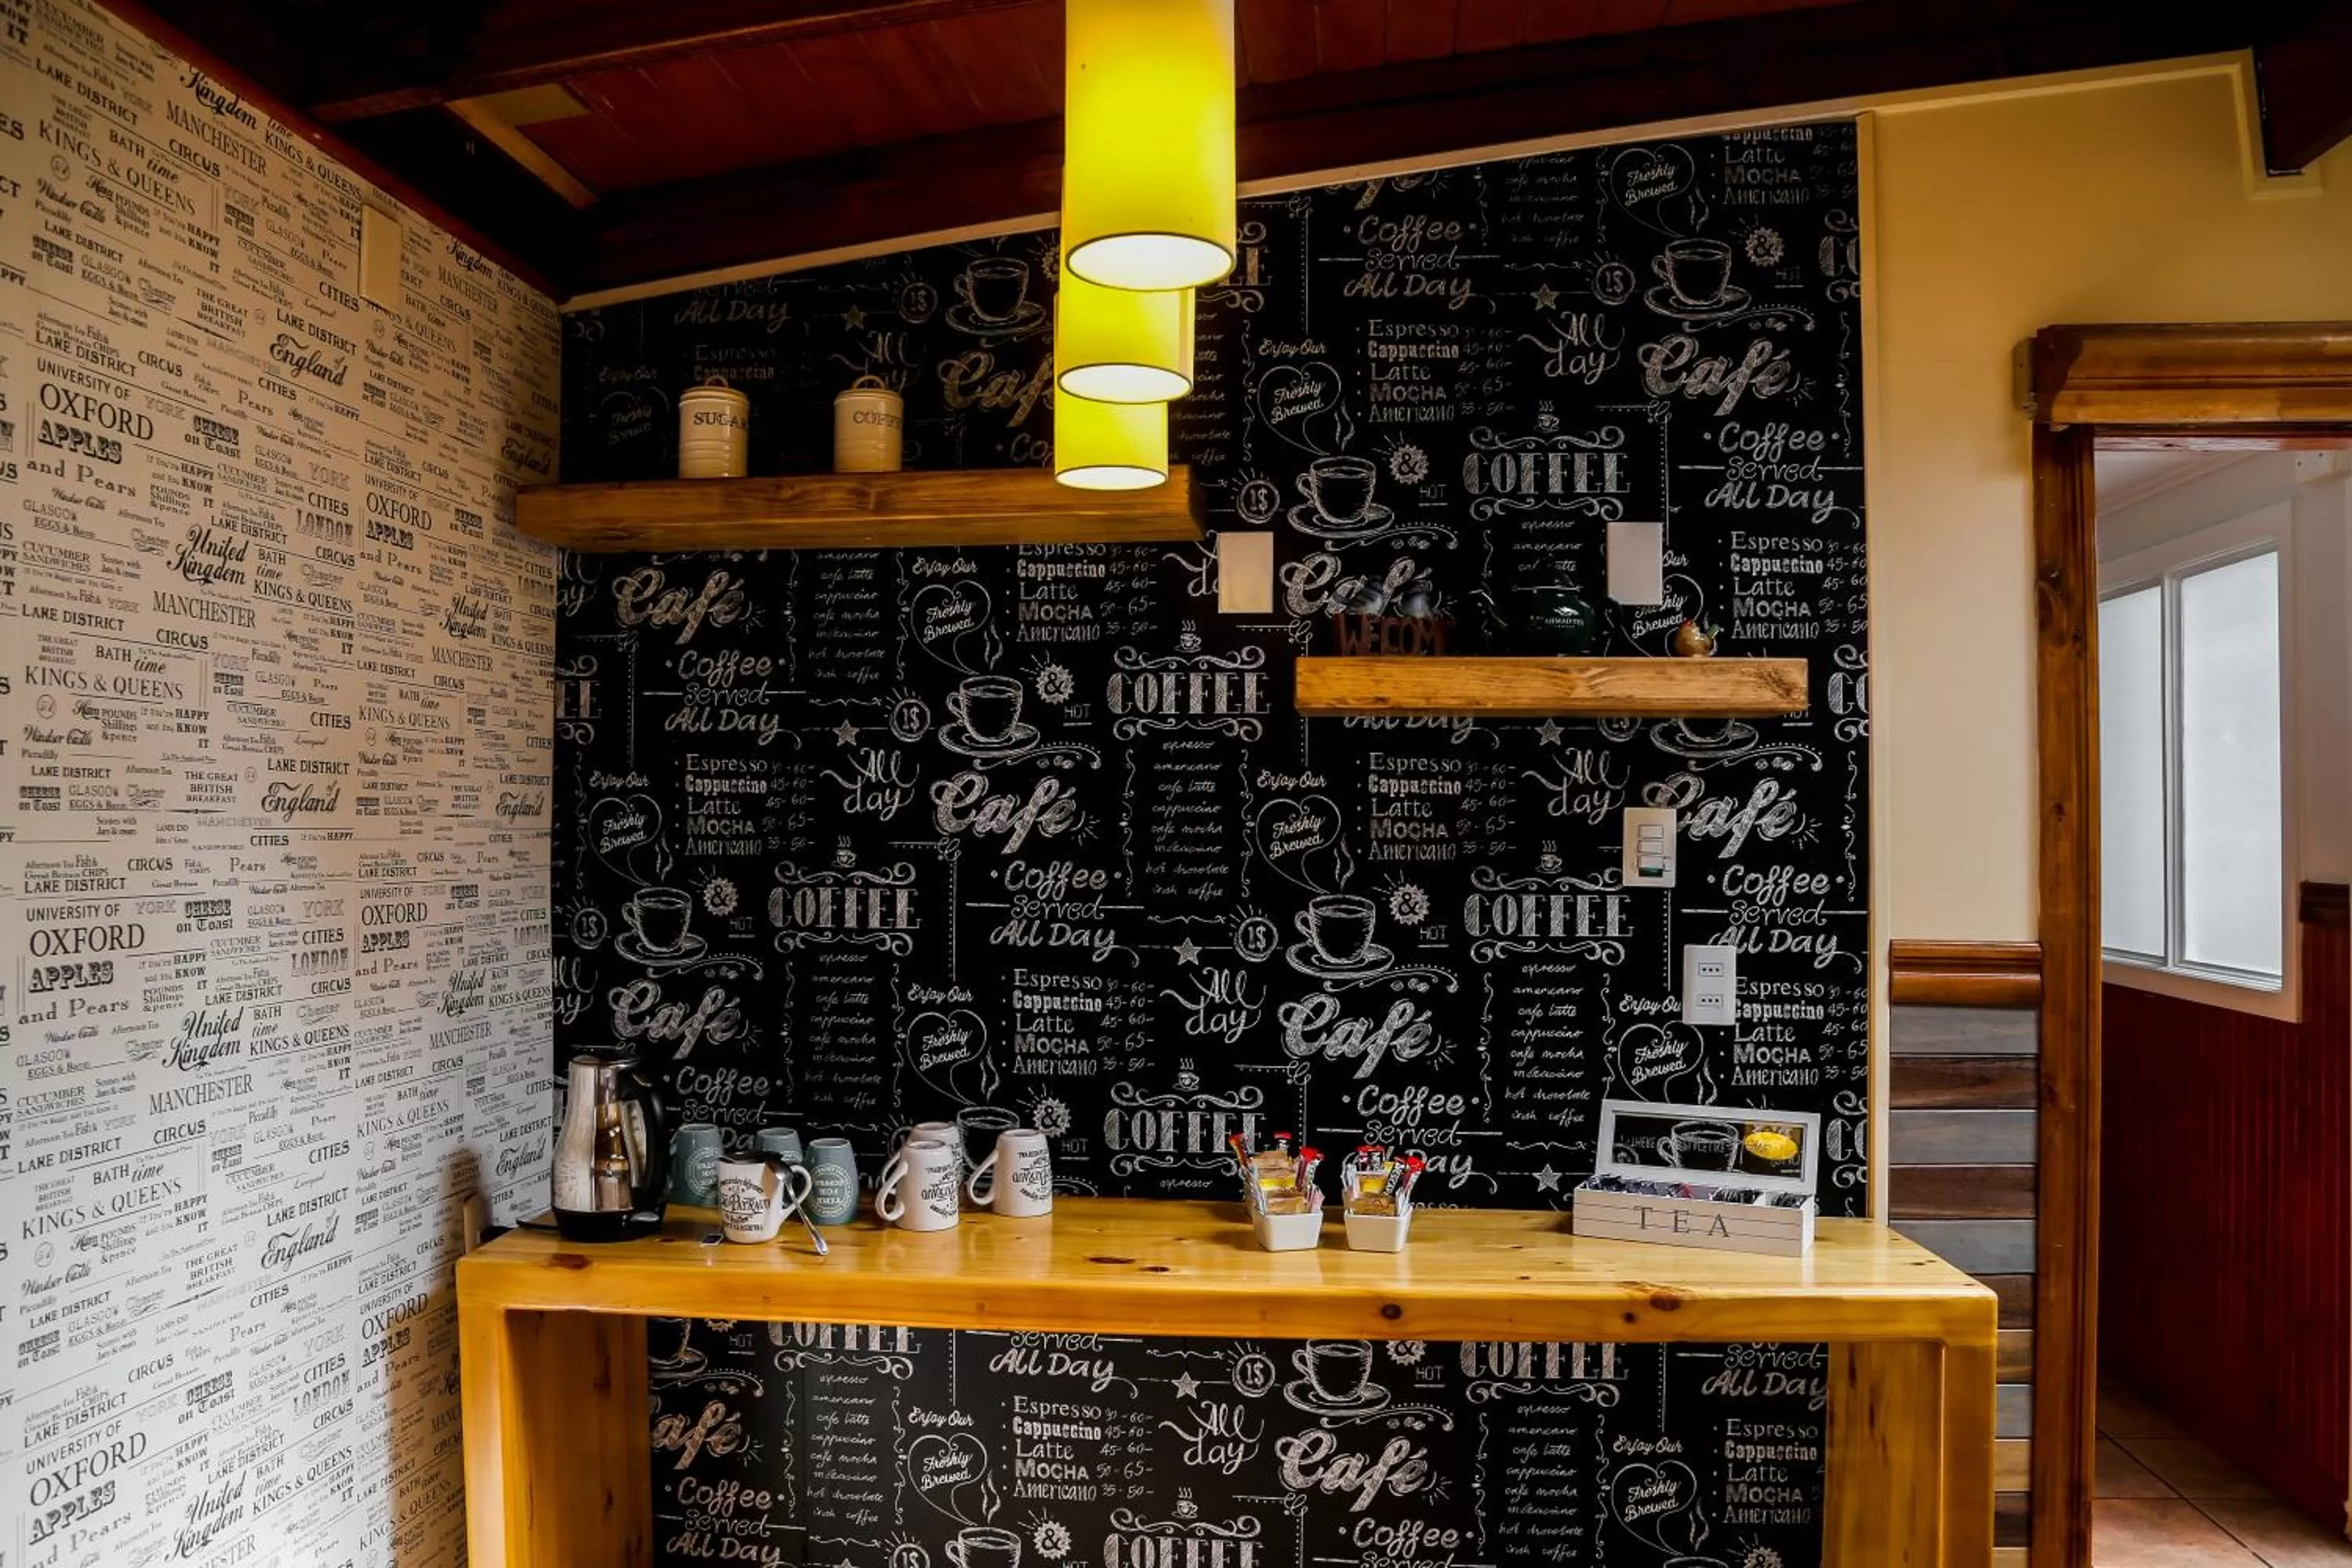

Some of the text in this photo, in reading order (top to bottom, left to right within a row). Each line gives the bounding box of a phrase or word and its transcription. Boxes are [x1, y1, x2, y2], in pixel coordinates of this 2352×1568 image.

[37, 58, 72, 89] LAKE
[78, 80, 139, 125] DISTRICT
[180, 65, 257, 130] Kingdom
[110, 129, 144, 158] BATH
[166, 100, 267, 176] MANCHESTER
[39, 119, 195, 216] KINGS & QUEENS
[169, 139, 220, 177] CIRCUS
[1358, 215, 1463, 251] Coffee
[1366, 245, 1460, 271] Served
[319, 282, 359, 312] CITIES
[1344, 274, 1471, 310] All Day
[277, 308, 358, 355] LAKE DISTRICT
[1368, 320, 1459, 339] Espresso
[138, 351, 183, 377] CIRCUS
[1367, 341, 1459, 361] Cappuccino
[37, 358, 131, 400] UNIVERSITY OF
[259, 377, 297, 401] CITIES
[1637, 333, 1791, 416] Café
[40, 383, 154, 441] OXFORD
[1369, 403, 1454, 422] Americano
[38, 419, 122, 464] APPLES
[1719, 422, 1825, 462] Coffee
[27, 459, 136, 498] and Pears
[1463, 452, 1630, 494] COFFEE
[1726, 456, 1824, 481] Served
[308, 492, 349, 516] CITIES
[367, 492, 431, 531] OXFORD
[1704, 482, 1835, 524] All Day
[187, 524, 249, 562] United
[296, 509, 354, 547] LONDON
[1730, 532, 1823, 552] Espresso
[166, 544, 245, 586] Kingdom
[316, 546, 354, 566] CIRCUS
[1730, 553, 1823, 574] Cappuccino
[1020, 582, 1078, 600] Latte
[1733, 577, 1795, 596] Latte
[22, 604, 125, 631] LAKE DISTRICT
[152, 590, 256, 628] MANCHESTER
[612, 567, 745, 645] Café
[156, 629, 209, 649] CIRCUS
[1017, 624, 1099, 642] Americano
[1731, 621, 1820, 639] Americano
[96, 646, 131, 662] BATH
[678, 650, 771, 686] Coffee
[25, 666, 183, 699] KINGS & QUEENS
[684, 681, 769, 706] Served
[1106, 673, 1270, 713] COFFEE
[310, 712, 351, 729] CITIES
[665, 707, 779, 745] All Day
[268, 758, 350, 775] LAKE DISTRICT
[686, 754, 768, 775] Espresso
[1369, 753, 1462, 771] Espresso
[684, 775, 768, 796] Cappuccino
[1368, 773, 1461, 795] Cappuccino
[930, 771, 1076, 855] Café
[250, 836, 289, 846] CITIES
[1004, 861, 1108, 899] Coffee
[1722, 864, 1830, 906] Coffee
[26, 903, 121, 921] UNIVERSITY OF
[361, 902, 427, 926] OXFORD
[768, 887, 923, 929] COFFEE
[1011, 894, 1104, 920] Served
[1464, 894, 1635, 937] COFFEE
[1729, 899, 1828, 926] Served
[30, 924, 145, 956] OXFORD
[303, 928, 344, 945] CITIES
[990, 920, 1115, 962] All Day
[1768, 929, 1837, 968] Day
[29, 960, 114, 993] APPLES
[292, 948, 348, 977] LONDON
[311, 978, 351, 995] CIRCUS
[1013, 969, 1102, 990] Espresso
[18, 997, 129, 1024] and Pears
[1012, 990, 1102, 1011] Cappuccino
[182, 1006, 243, 1038] United
[1016, 1014, 1075, 1033] Latte
[1278, 993, 1433, 1080] Café
[162, 1034, 241, 1072] Kingdom
[1013, 1056, 1097, 1075] Americano
[150, 1074, 252, 1115] MANCHESTER
[1357, 1085, 1465, 1125] Coffee
[1363, 1120, 1462, 1146] Served
[18, 1138, 122, 1174] LAKE DISTRICT
[309, 1141, 350, 1165] CITIES
[22, 1178, 181, 1240] KINGS & QUEENS
[1635, 1206, 1730, 1237] TEA
[293, 1370, 351, 1419] LONDON
[313, 1399, 354, 1429] CIRCUS
[1726, 1419, 1818, 1439] Espresso
[1016, 1442, 1073, 1461] Latte
[30, 1432, 147, 1508] OXFORD
[1275, 1428, 1428, 1512] Café
[30, 1481, 117, 1544] APPLES
[677, 1476, 773, 1518] Coffee
[684, 1508, 770, 1538] Served
